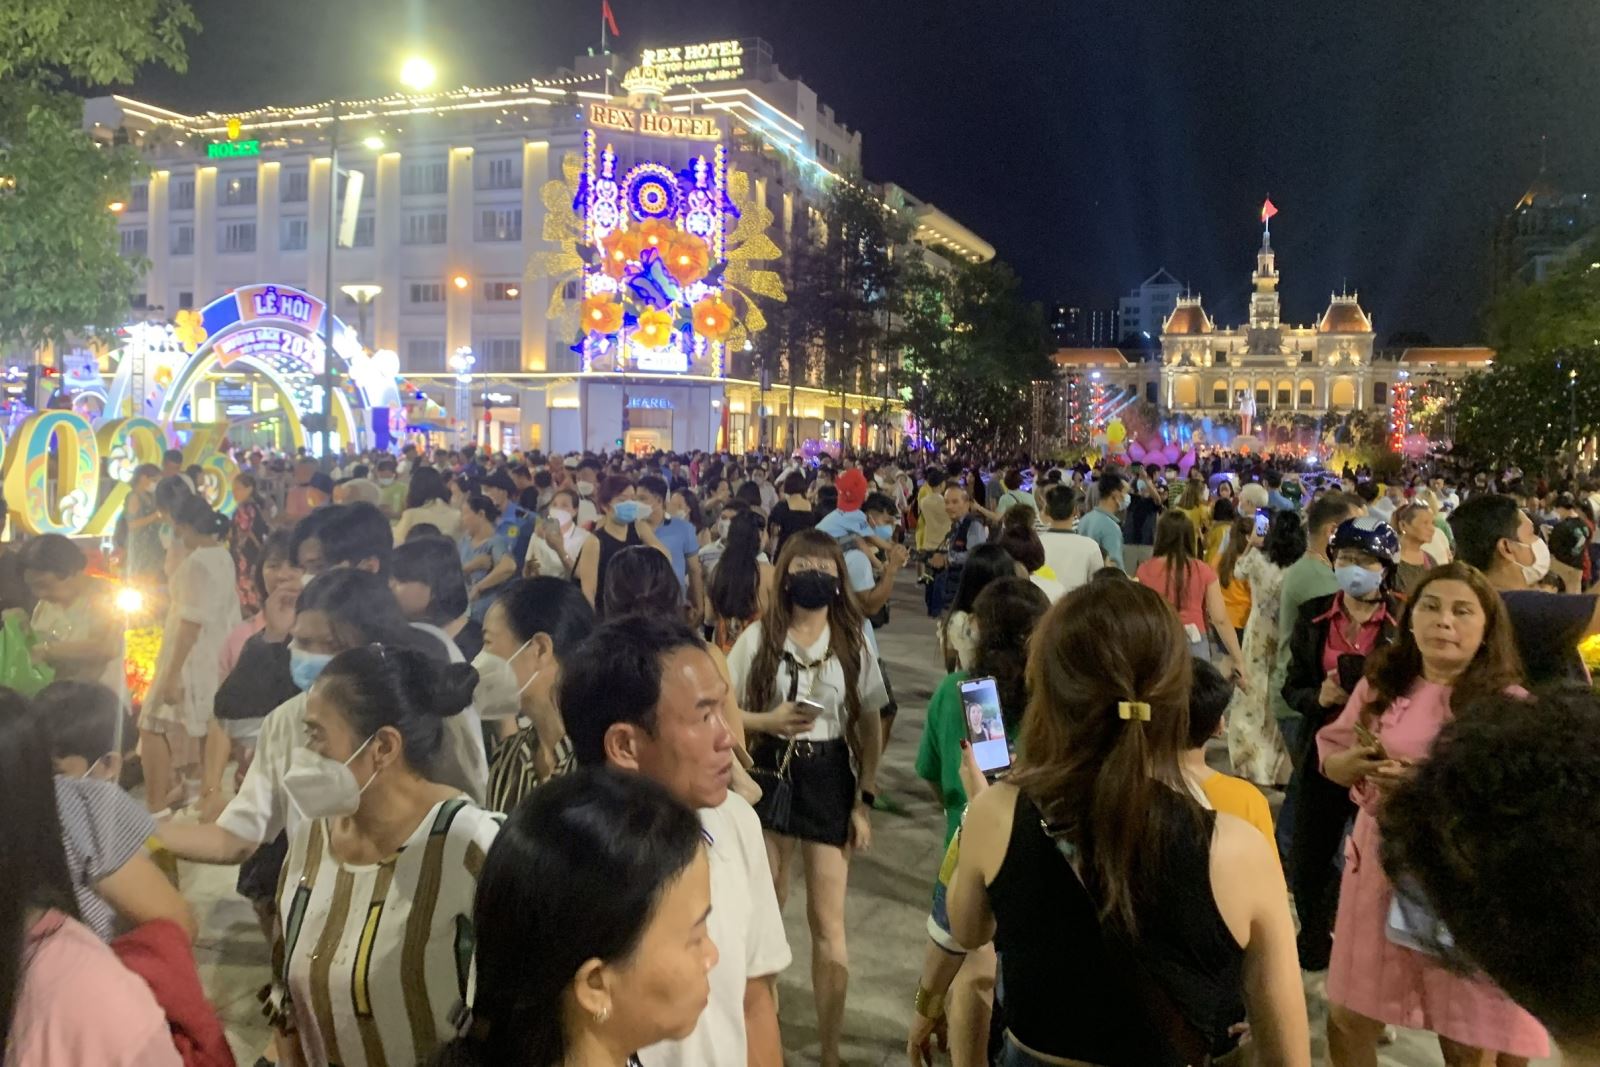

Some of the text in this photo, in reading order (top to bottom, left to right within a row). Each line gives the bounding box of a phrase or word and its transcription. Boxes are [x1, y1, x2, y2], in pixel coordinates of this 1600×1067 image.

[642, 40, 743, 63] REX HOTEL
[721, 56, 741, 67] BAR
[591, 103, 720, 138] REX HOTEL
[208, 140, 260, 159] ROLEX
[281, 332, 322, 367] 202
[0, 408, 241, 537] 023
